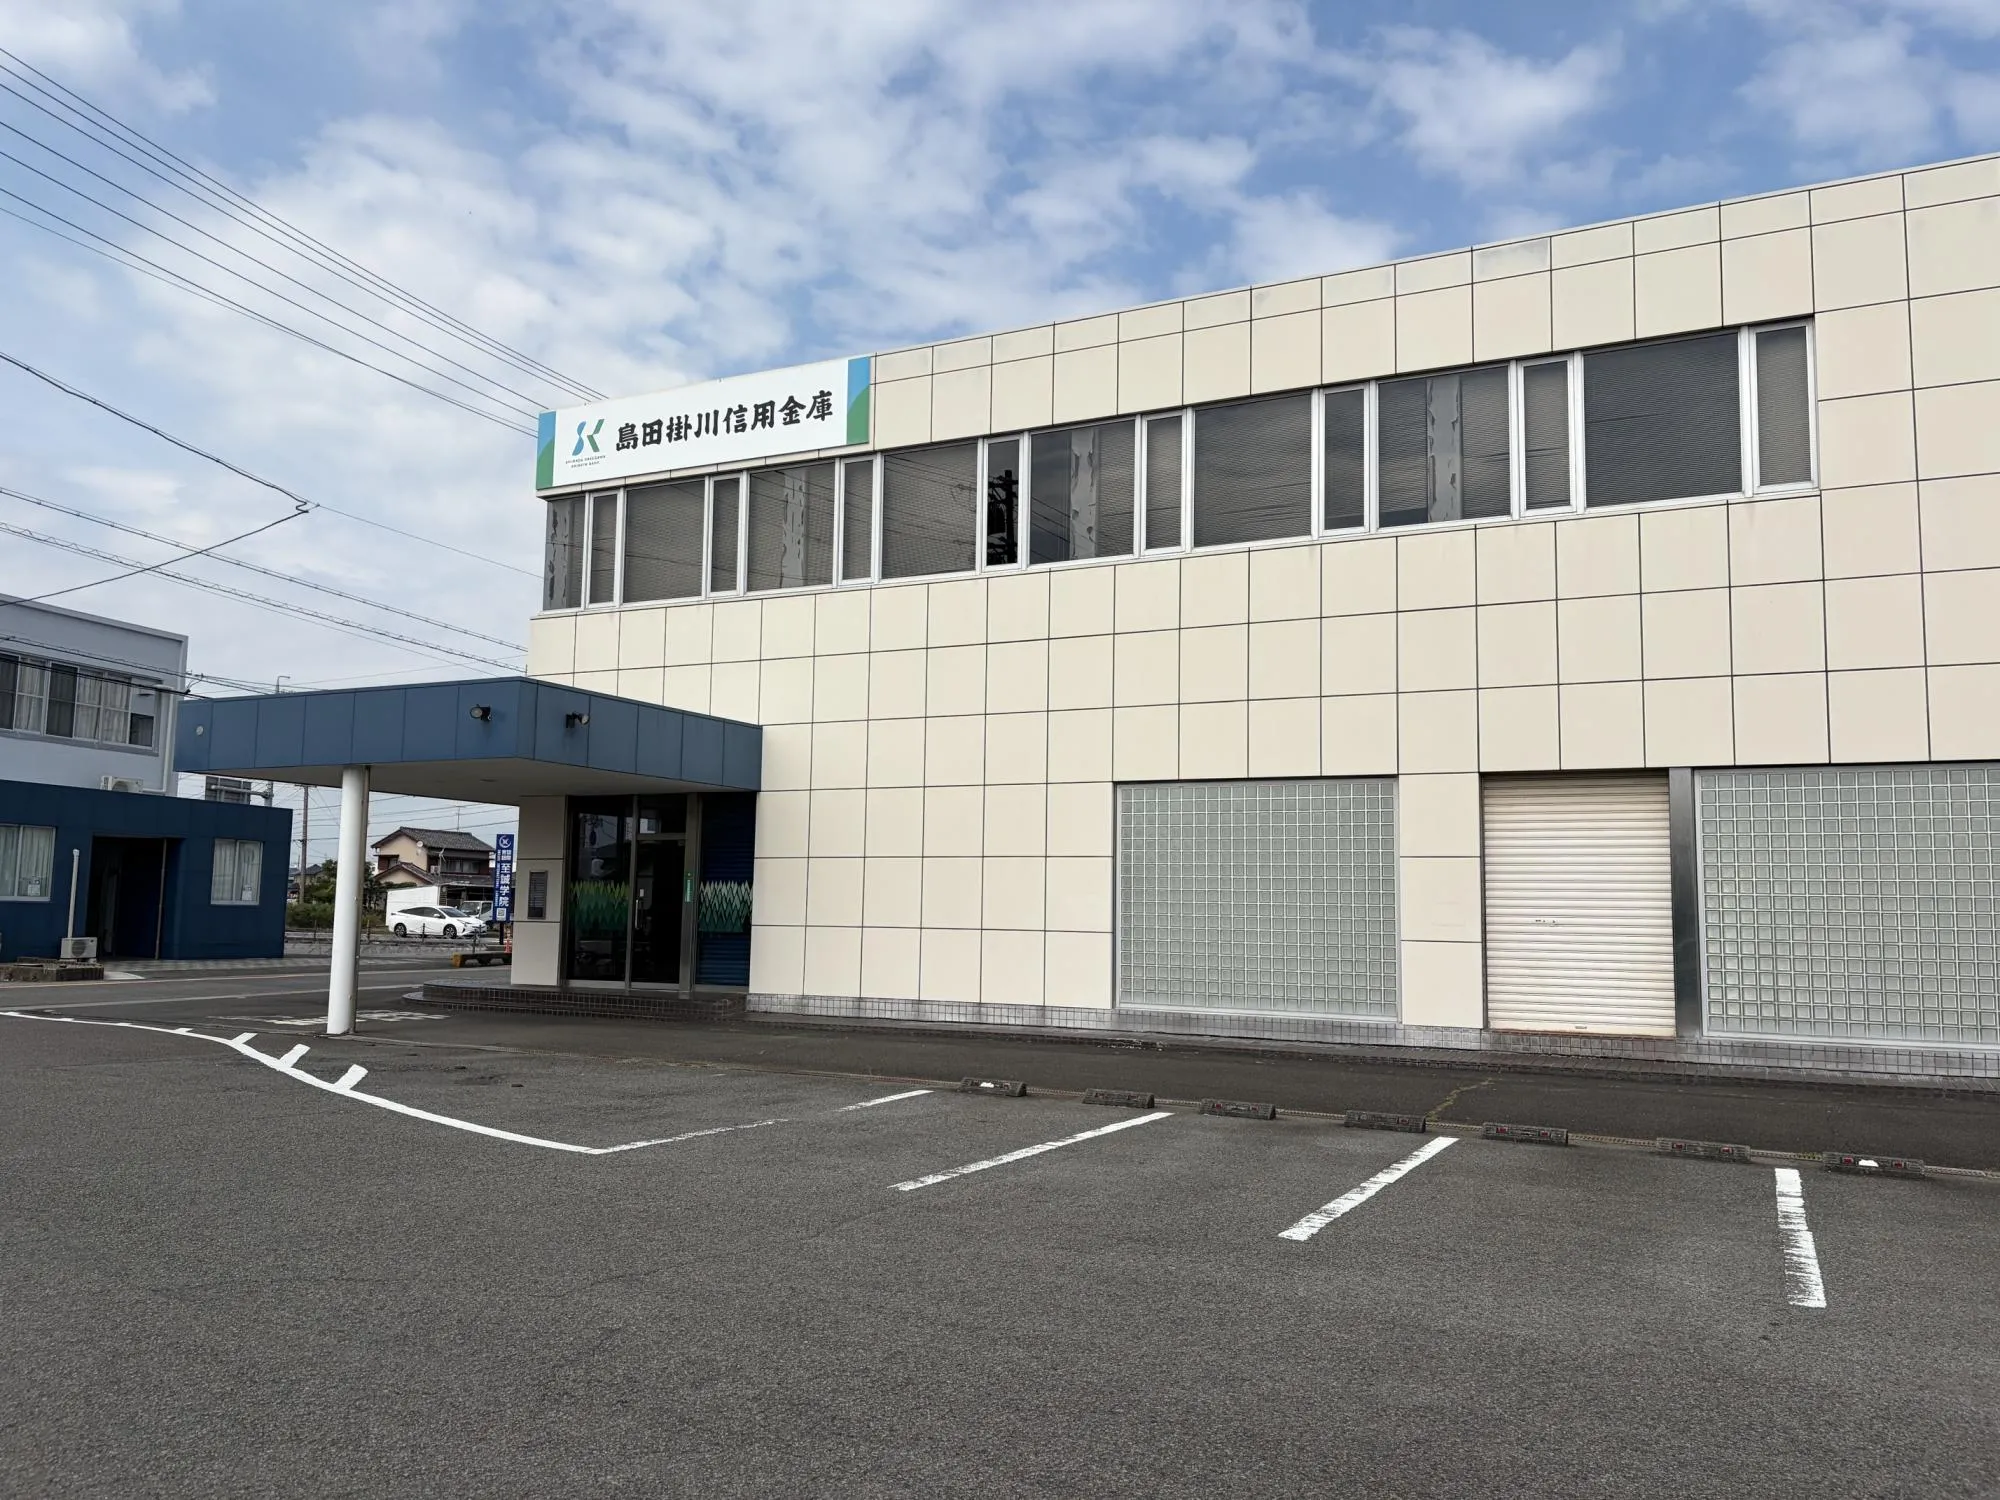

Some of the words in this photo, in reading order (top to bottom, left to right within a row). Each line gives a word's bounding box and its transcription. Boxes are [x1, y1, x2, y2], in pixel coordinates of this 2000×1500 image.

[615, 390, 833, 451] 島田掛川信用金庫
